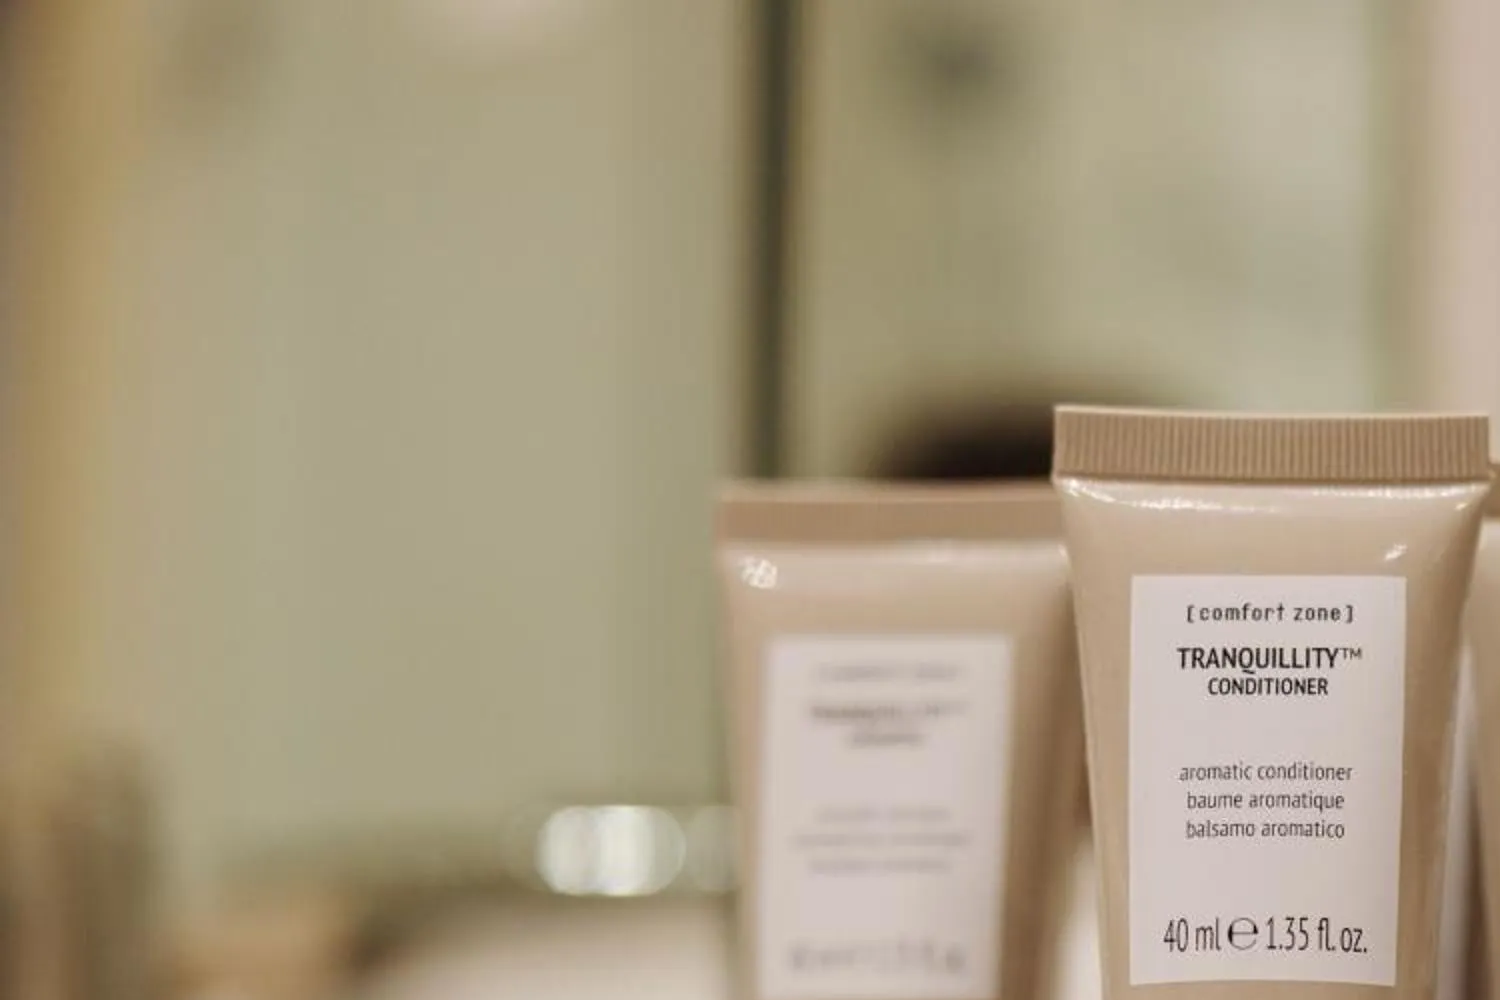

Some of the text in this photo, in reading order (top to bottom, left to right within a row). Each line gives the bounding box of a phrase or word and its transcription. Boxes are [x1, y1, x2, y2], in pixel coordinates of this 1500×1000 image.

[1207, 677, 1329, 695] CONDITIONER
[1179, 762, 1353, 781] aromatic conditioner
[1187, 790, 1345, 812] baume aromatique
[1185, 819, 1345, 839] balsamo aromatico
[1163, 917, 1189, 952] 40
[1195, 917, 1221, 951] ml
[1266, 916, 1309, 951] 1.35
